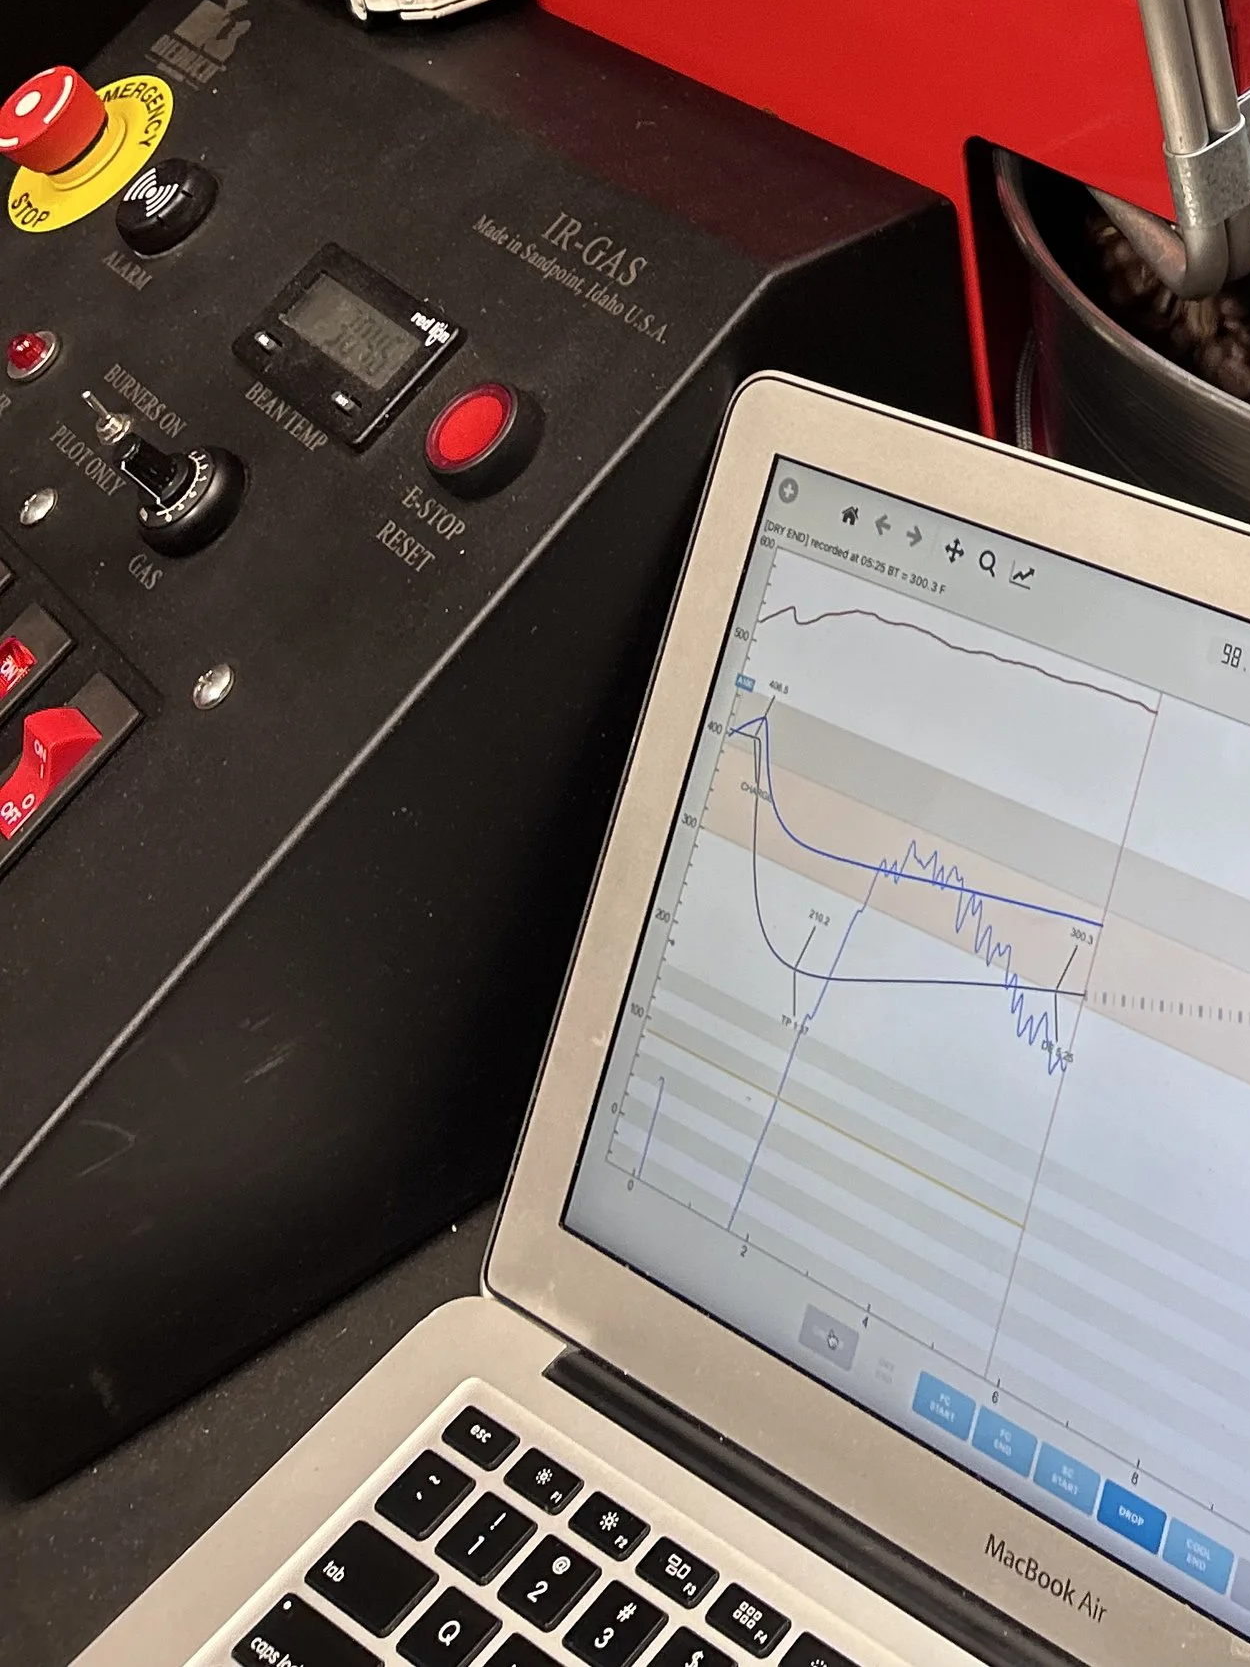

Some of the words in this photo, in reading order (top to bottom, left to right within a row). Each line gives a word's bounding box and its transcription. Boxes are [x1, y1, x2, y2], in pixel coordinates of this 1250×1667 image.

[98, 82, 166, 148] MERGENCY
[12, 192, 50, 229] STOP
[541, 212, 648, 286] IR-GAS
[102, 250, 153, 291] ALARM
[472, 214, 509, 245] Made
[506, 234, 523, 255] in
[519, 243, 586, 296] Sandpoint,
[584, 281, 625, 316] Idaho
[623, 303, 670, 345] U.S.A.
[411, 311, 432, 332] red
[104, 363, 165, 422] BURNERS
[158, 410, 188, 439] ON
[245, 381, 292, 425] BEAN
[287, 409, 329, 452] TEMP
[49, 424, 91, 467] PILOT
[83, 455, 127, 497] ONLY
[402, 485, 466, 541] E-STOP
[376, 519, 436, 572] RESET
[128, 553, 164, 590] GAS
[811, 537, 854, 560] recorded
[850, 550, 860, 564] at
[909, 573, 938, 593] 300.3
[734, 627, 750, 643] 500
[707, 719, 723, 735] 400
[33, 738, 47, 764] ON
[0, 801, 22, 825] OFF
[682, 811, 698, 830] 300
[655, 908, 672, 925] 200
[630, 1003, 646, 1019] 100
[611, 1102, 618, 1116] 0
[627, 1179, 635, 1193] 0
[740, 1245, 748, 1259] 2
[861, 1315, 870, 1329] 4
[991, 1390, 999, 1405] 6
[469, 1424, 492, 1444] esc
[1130, 1471, 1139, 1486] 8
[550, 1490, 563, 1504] F1
[489, 1512, 507, 1531] !
[1118, 1504, 1145, 1527] DROP
[467, 1535, 485, 1556] 1
[613, 1533, 629, 1550] F2
[322, 1559, 346, 1583] tab
[551, 1555, 572, 1576] @
[984, 1532, 1077, 1607] MacBook
[1077, 1585, 1109, 1624] Air
[527, 1579, 549, 1604] 2
[682, 1581, 698, 1598] F3
[616, 1601, 638, 1623] #
[438, 1620, 461, 1647] Q
[593, 1627, 615, 1650] 3
[752, 1629, 769, 1646] F4
[250, 1636, 282, 1665] caps
